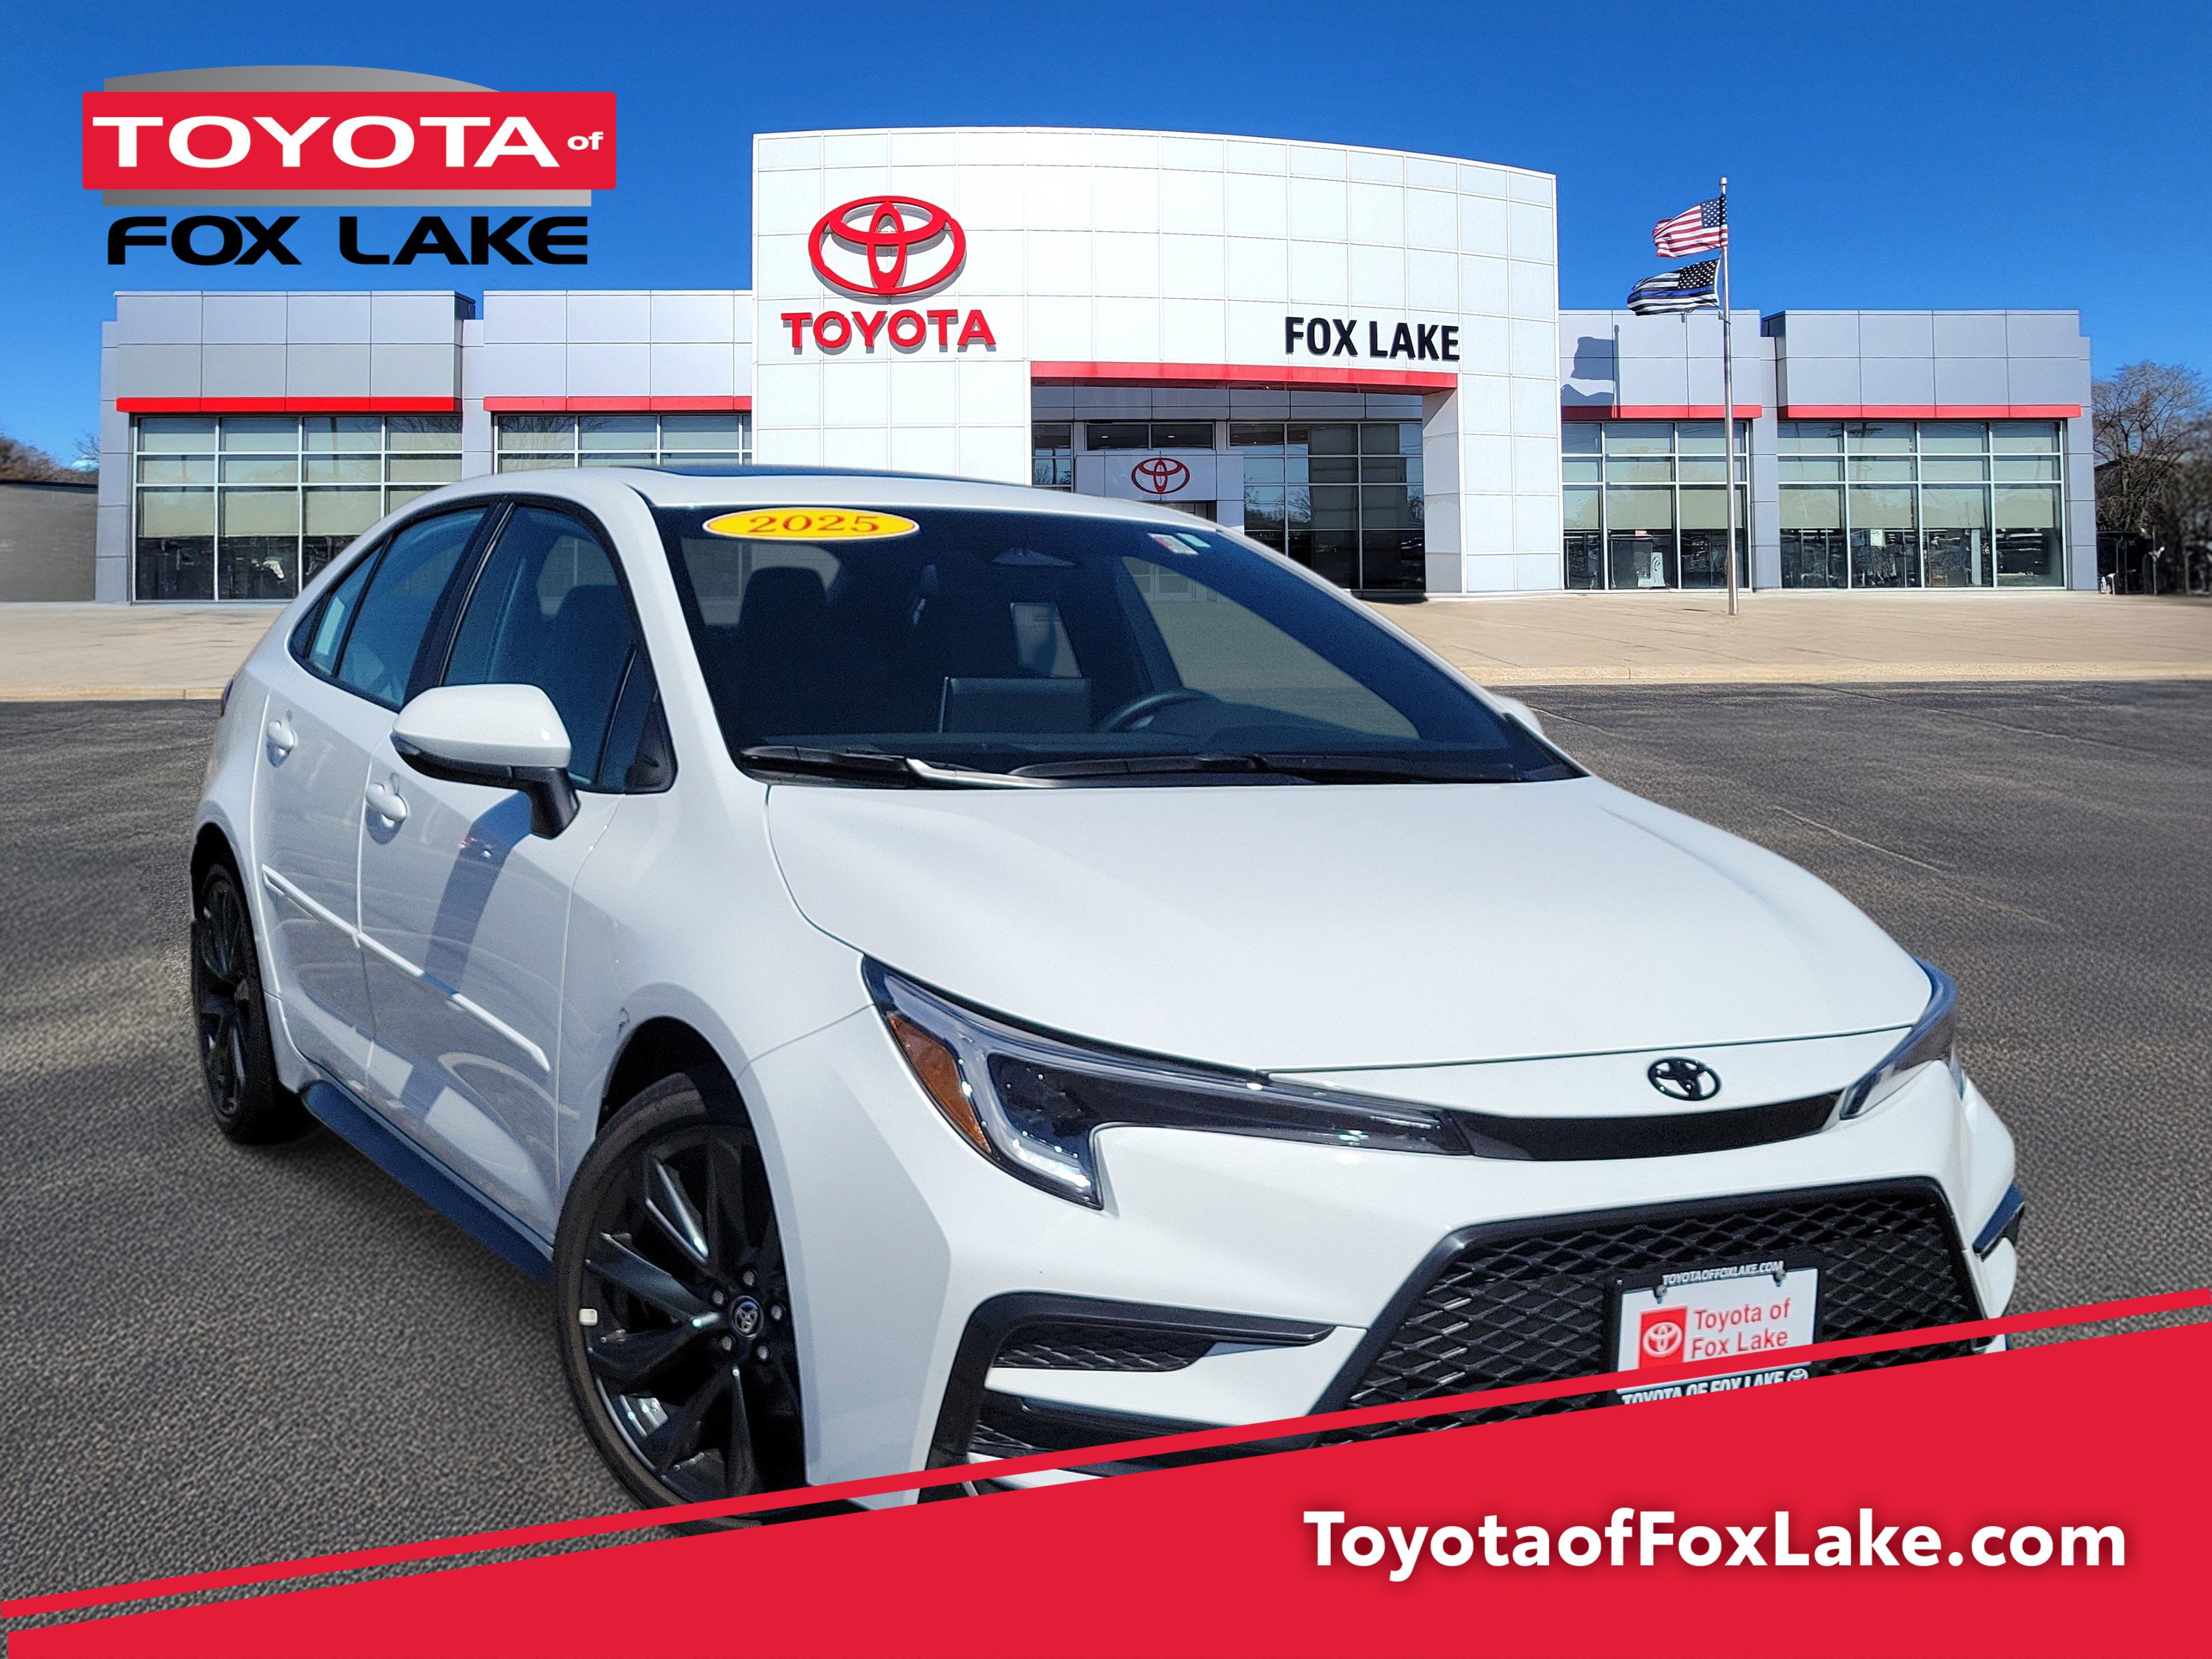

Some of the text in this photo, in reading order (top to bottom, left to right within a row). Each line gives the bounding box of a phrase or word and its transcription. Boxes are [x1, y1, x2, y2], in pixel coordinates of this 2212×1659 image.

[781, 309, 997, 356] TOYOTA
[1285, 316, 1460, 361] FOX LAKE
[748, 514, 880, 534] 2025
[1695, 1297, 1791, 1333] Toyota of
[1692, 1328, 1788, 1359] Fox Lake
